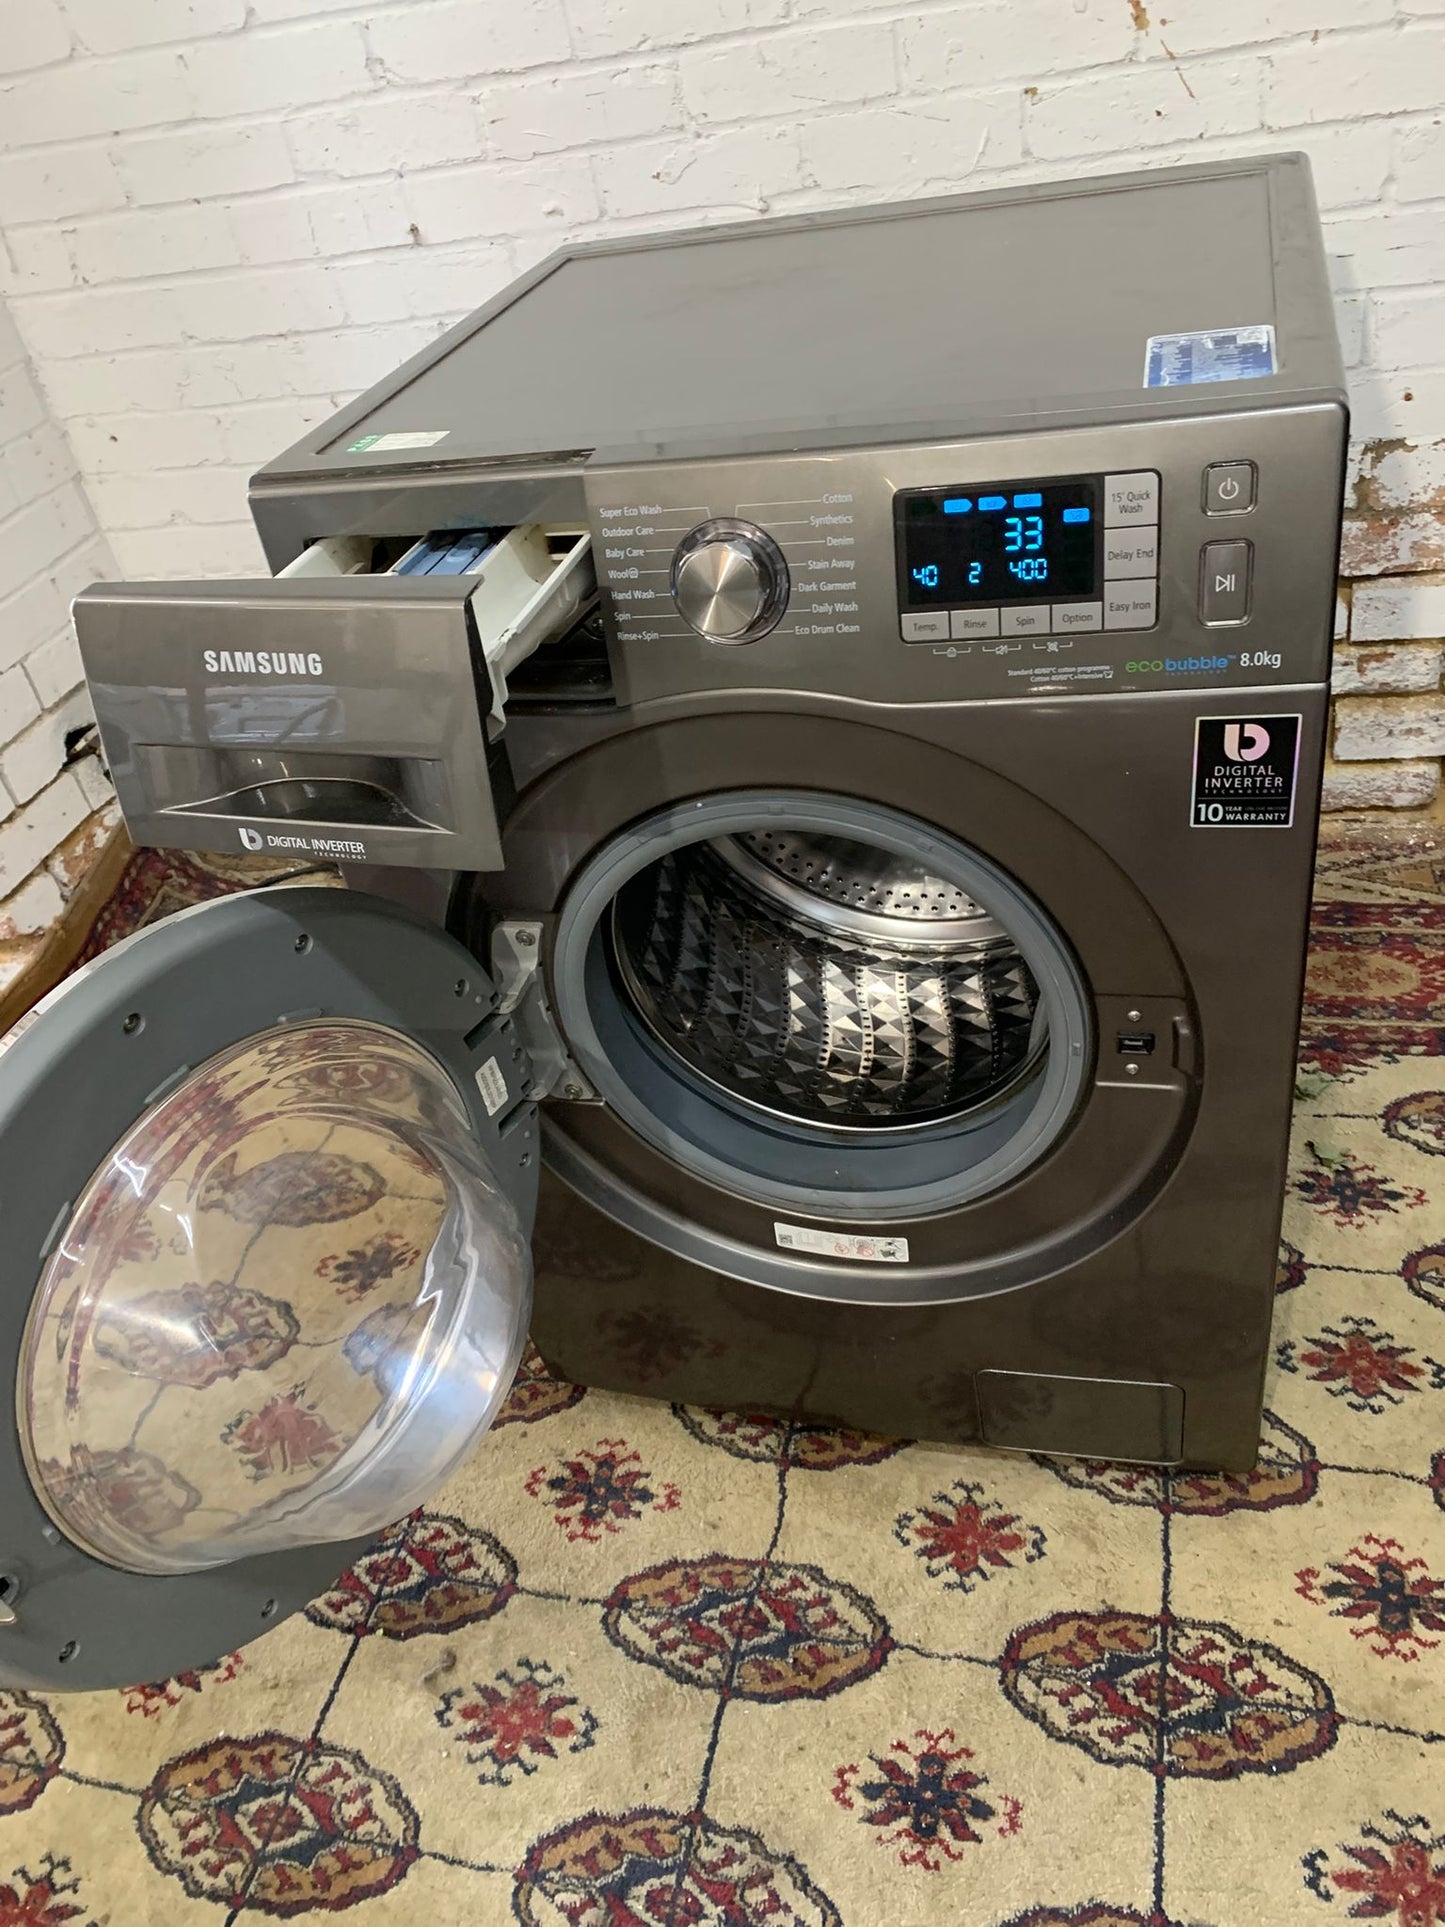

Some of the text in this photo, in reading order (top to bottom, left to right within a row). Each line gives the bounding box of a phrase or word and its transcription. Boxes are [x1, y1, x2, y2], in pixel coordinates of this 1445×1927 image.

[822, 493, 853, 504] Cotton
[1126, 490, 1151, 502] Quick
[600, 504, 662, 519] Super Eco Wash
[1118, 504, 1144, 514] Wash
[810, 514, 854, 527] Synthetics
[602, 526, 655, 538] Outdoor Care
[1003, 515, 1043, 551] 33
[826, 536, 855, 547] Denim
[605, 547, 645, 559] Baby Care
[1107, 548, 1155, 562] Delay End
[808, 559, 855, 570] Stain Away
[1009, 557, 1048, 580] 400
[608, 569, 629, 579] Wool
[912, 564, 938, 587] 40
[968, 562, 982, 584] 2
[798, 581, 856, 592] Dark Garment
[611, 589, 655, 600] Hand Wash
[812, 601, 858, 615] Daily Wash
[1109, 601, 1151, 613] Easy Iron
[614, 611, 631, 622] Spin
[1015, 616, 1035, 627] Spin
[1062, 613, 1093, 625] Option
[795, 623, 860, 635] Eco Drum Clean
[913, 622, 938, 633] Temp.
[963, 619, 987, 629] Rinse
[617, 630, 659, 642] Rinse+Spin
[203, 650, 323, 676] SAMSUNG
[1240, 650, 1281, 669] 8.0kg
[1214, 765, 1275, 777] DIGITAL
[1205, 777, 1283, 788] INVERTER
[1197, 803, 1224, 822] 10
[1225, 813, 1287, 821] WARRANTY
[266, 835, 311, 850] DIGITAL
[311, 838, 365, 854] INVERTER
[314, 851, 367, 860] TECHNOLOGY
